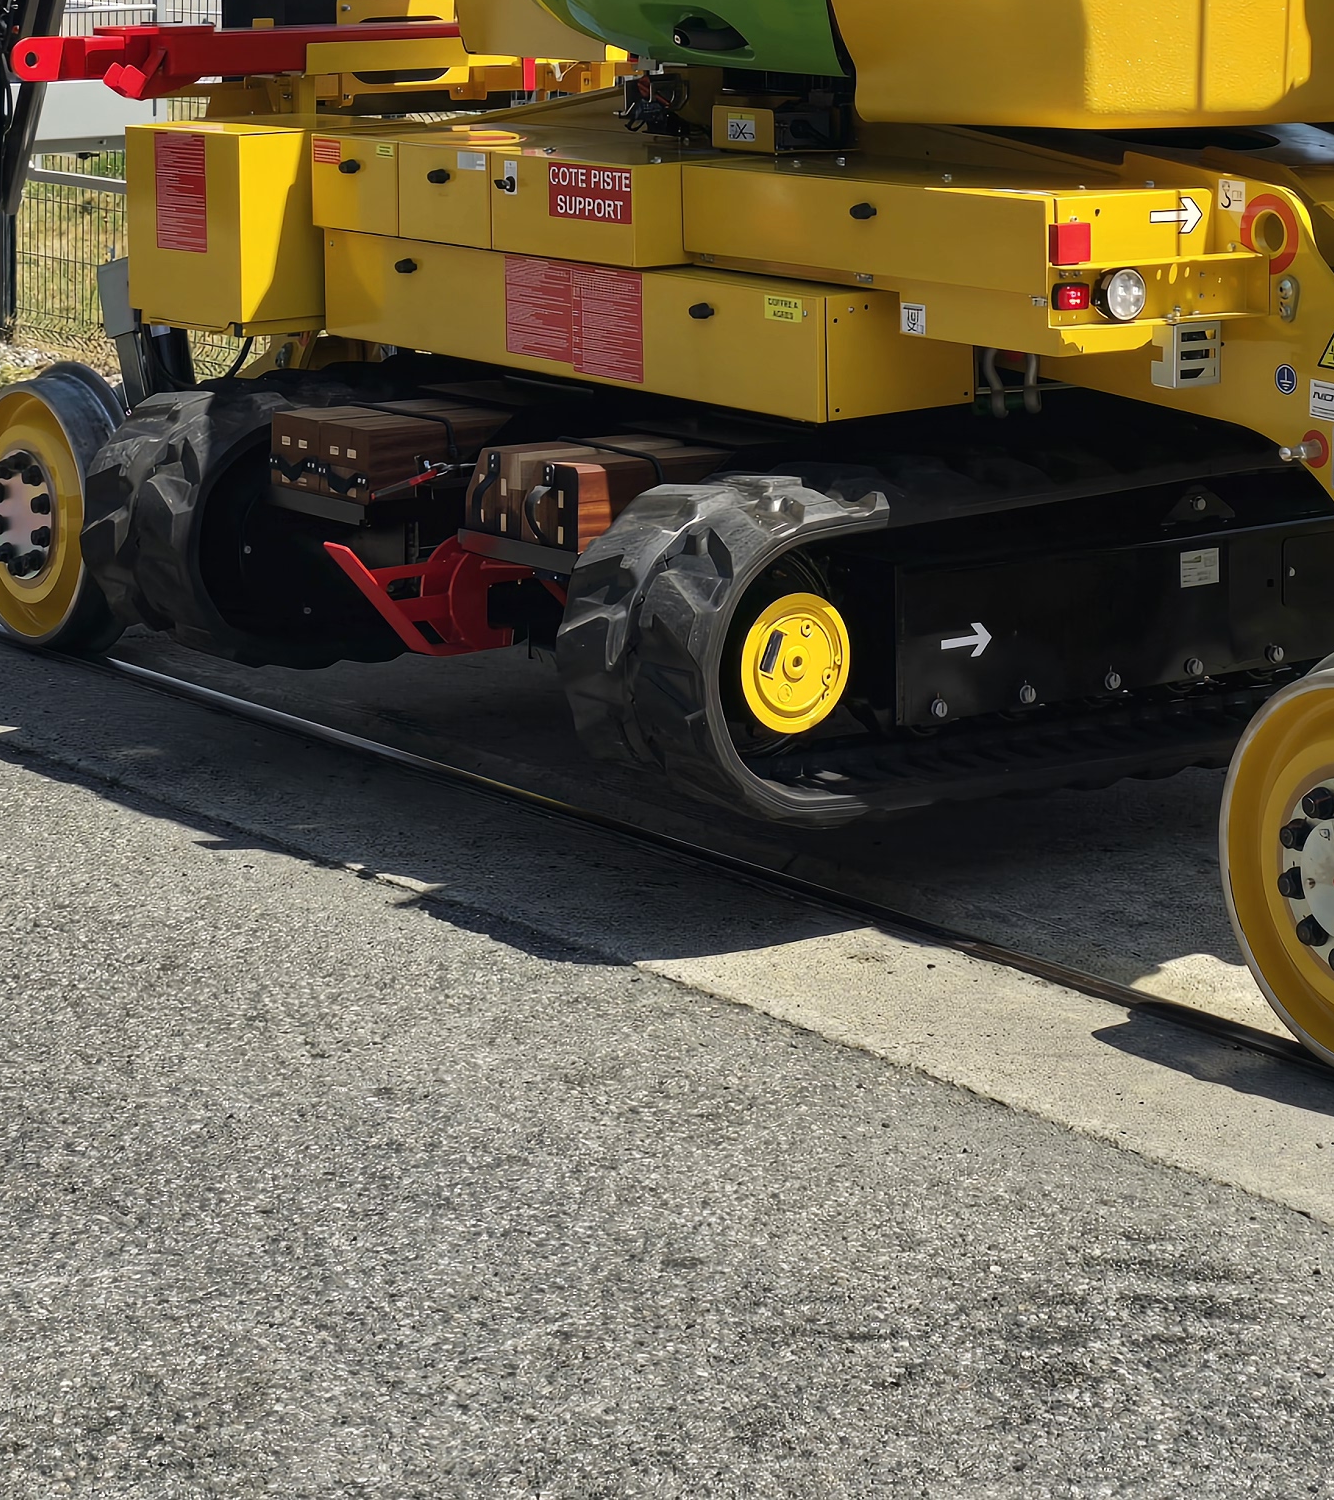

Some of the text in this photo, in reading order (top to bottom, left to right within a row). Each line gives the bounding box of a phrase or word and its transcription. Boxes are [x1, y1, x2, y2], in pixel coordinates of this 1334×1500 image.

[549, 166, 631, 191] COTE PISTE
[557, 195, 623, 219] SUPPORT
